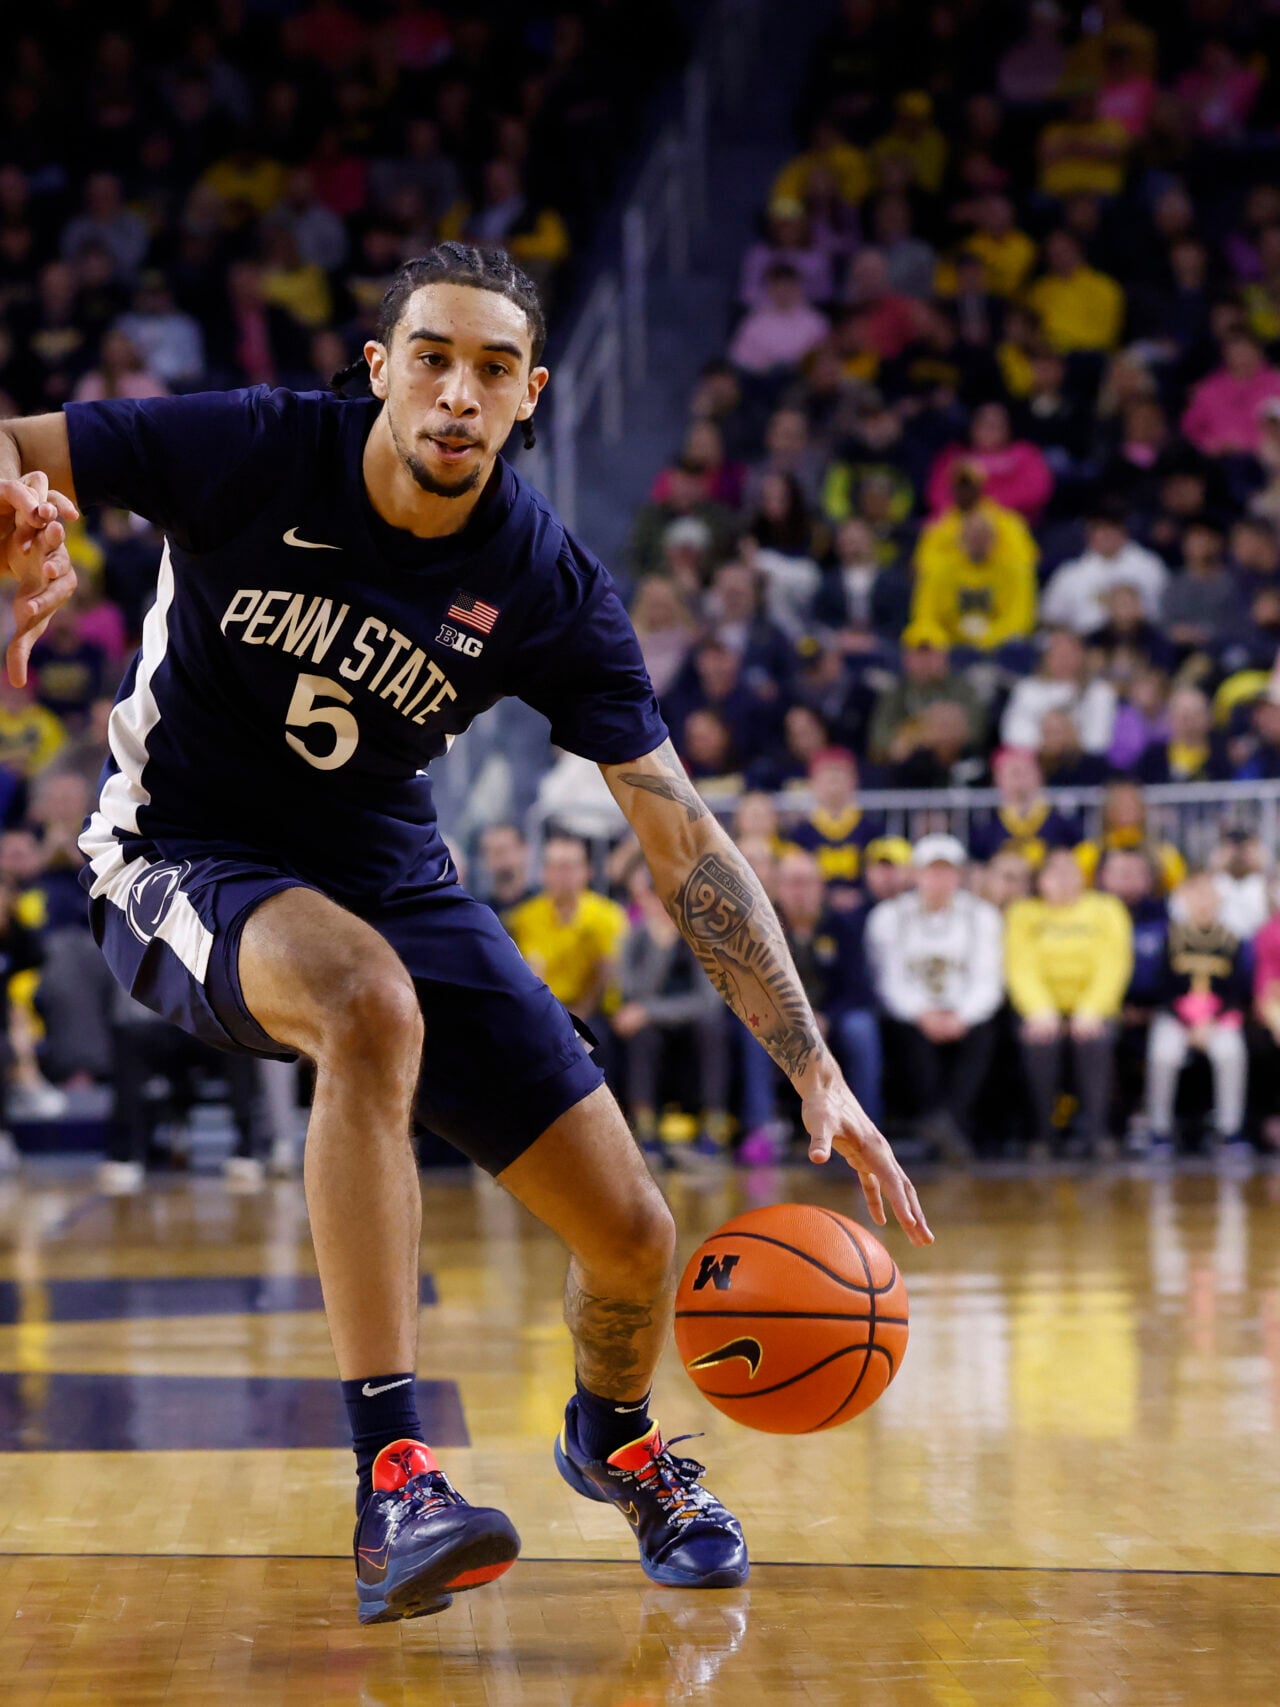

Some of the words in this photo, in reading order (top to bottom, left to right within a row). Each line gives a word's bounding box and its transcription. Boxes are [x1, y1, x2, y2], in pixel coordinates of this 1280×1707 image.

[220, 589, 350, 664] PENN
[338, 616, 457, 725] STATE
[285, 672, 359, 770] 5
[691, 883, 737, 932] 95
[707, 864, 747, 900] INTERSTATE
